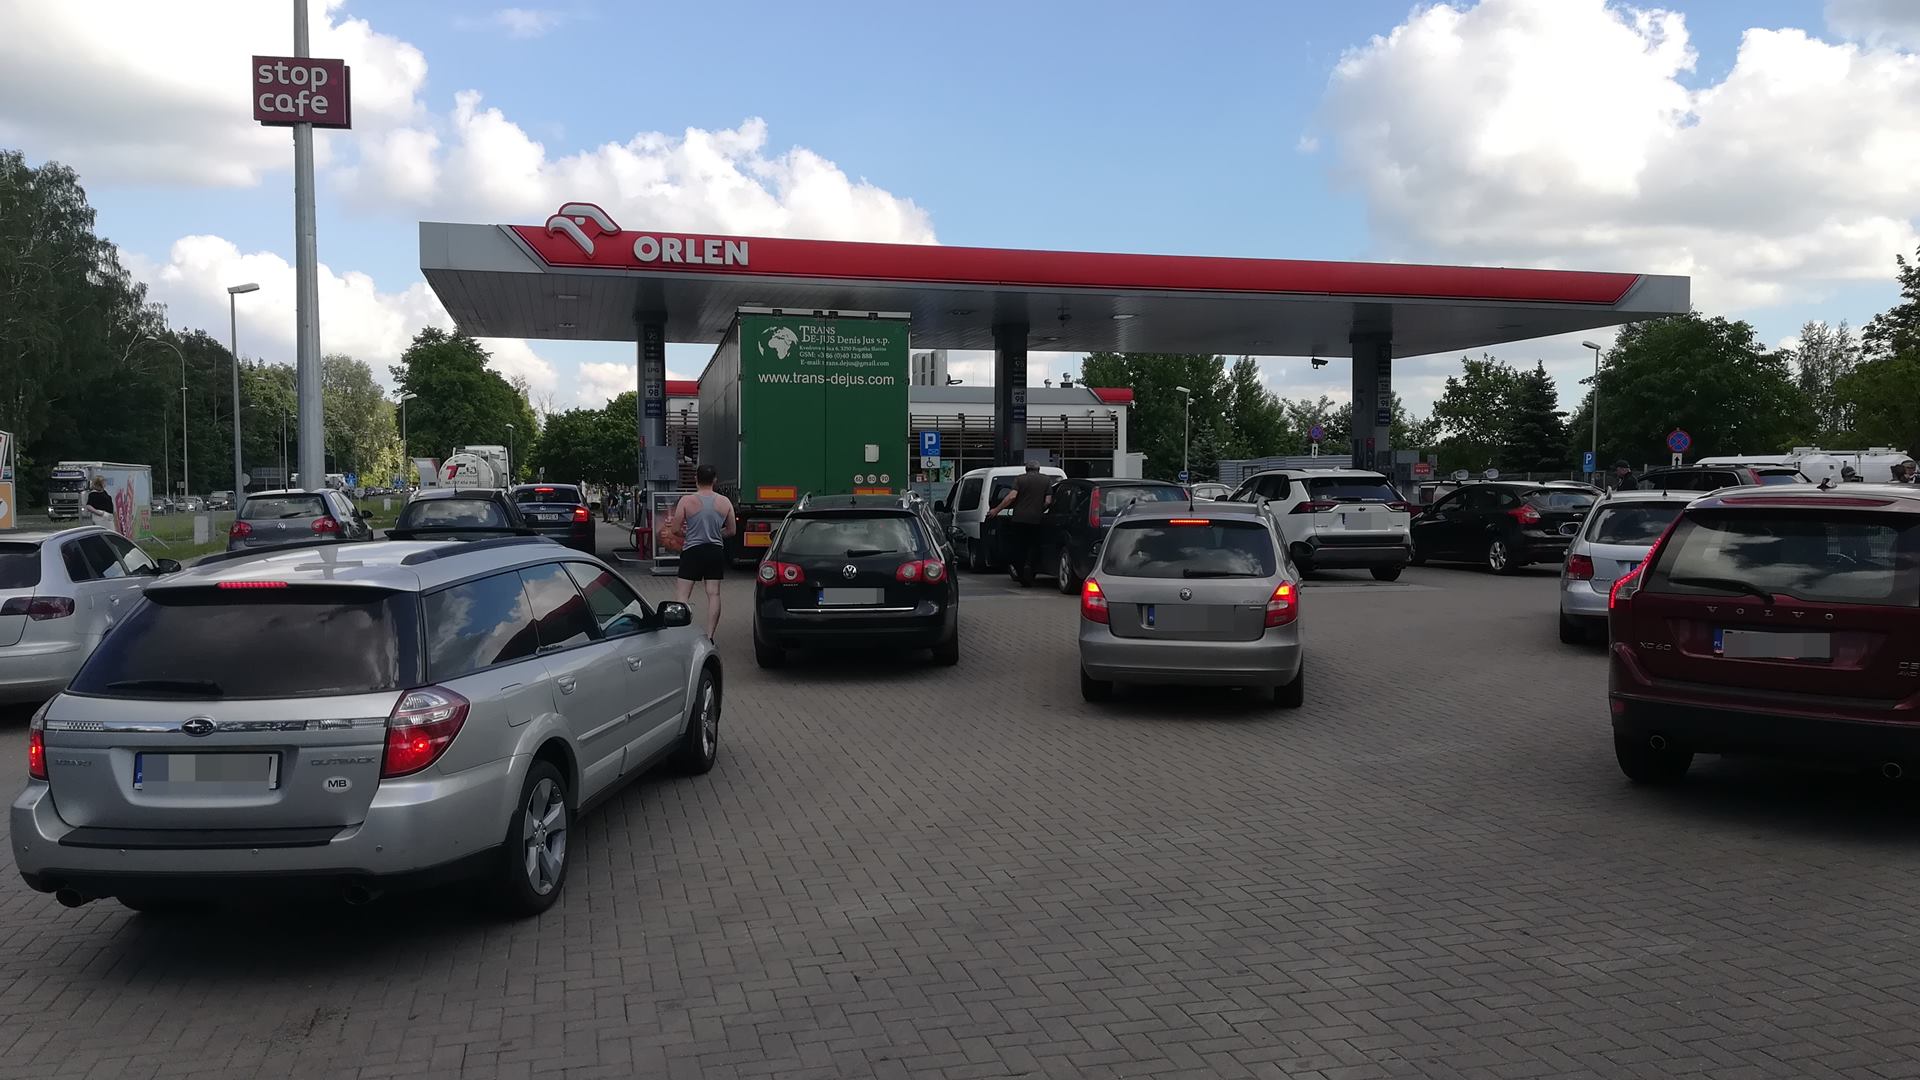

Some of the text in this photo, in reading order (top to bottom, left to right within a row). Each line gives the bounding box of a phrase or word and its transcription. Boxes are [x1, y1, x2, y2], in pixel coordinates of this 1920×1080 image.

[258, 61, 328, 92] stop
[259, 90, 328, 117] cafe
[633, 236, 749, 266] ORLEN
[799, 325, 836, 335] TRANS
[837, 335, 861, 344] Denis
[862, 336, 875, 345] Jus
[876, 337, 890, 346] s.p.
[758, 372, 895, 388] www.trans-dejus.com
[648, 389, 659, 397] 98
[925, 433, 936, 449] P
[1586, 453, 1592, 465] P
[1705, 606, 1834, 620] VOLVO
[1639, 641, 1672, 651] XC60
[311, 757, 375, 766] OUTBACK
[328, 779, 347, 788] MB
